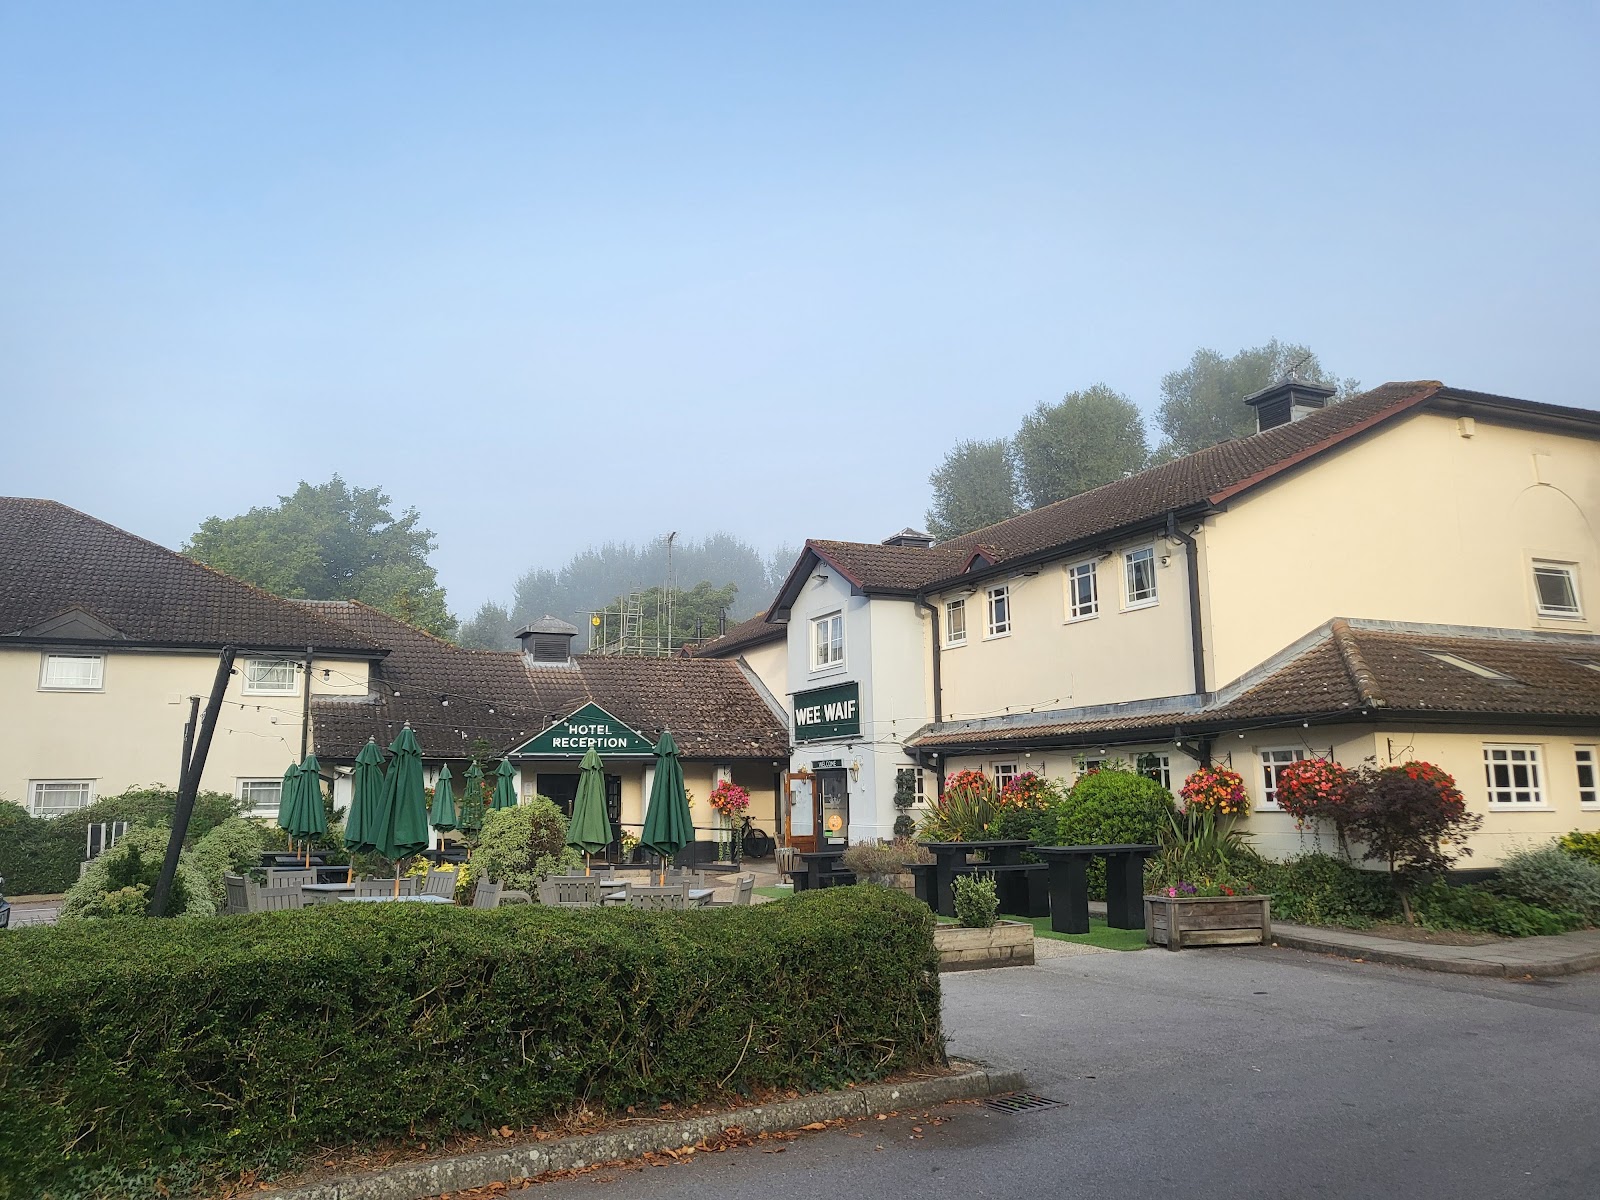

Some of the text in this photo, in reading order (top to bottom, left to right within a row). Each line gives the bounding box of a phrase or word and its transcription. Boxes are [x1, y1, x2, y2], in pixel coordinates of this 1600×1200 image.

[795, 700, 856, 726] WEE WAIF
[569, 725, 612, 735] HOTEL
[553, 738, 627, 748] RECEPTION
[818, 760, 837, 768] WELCOME
